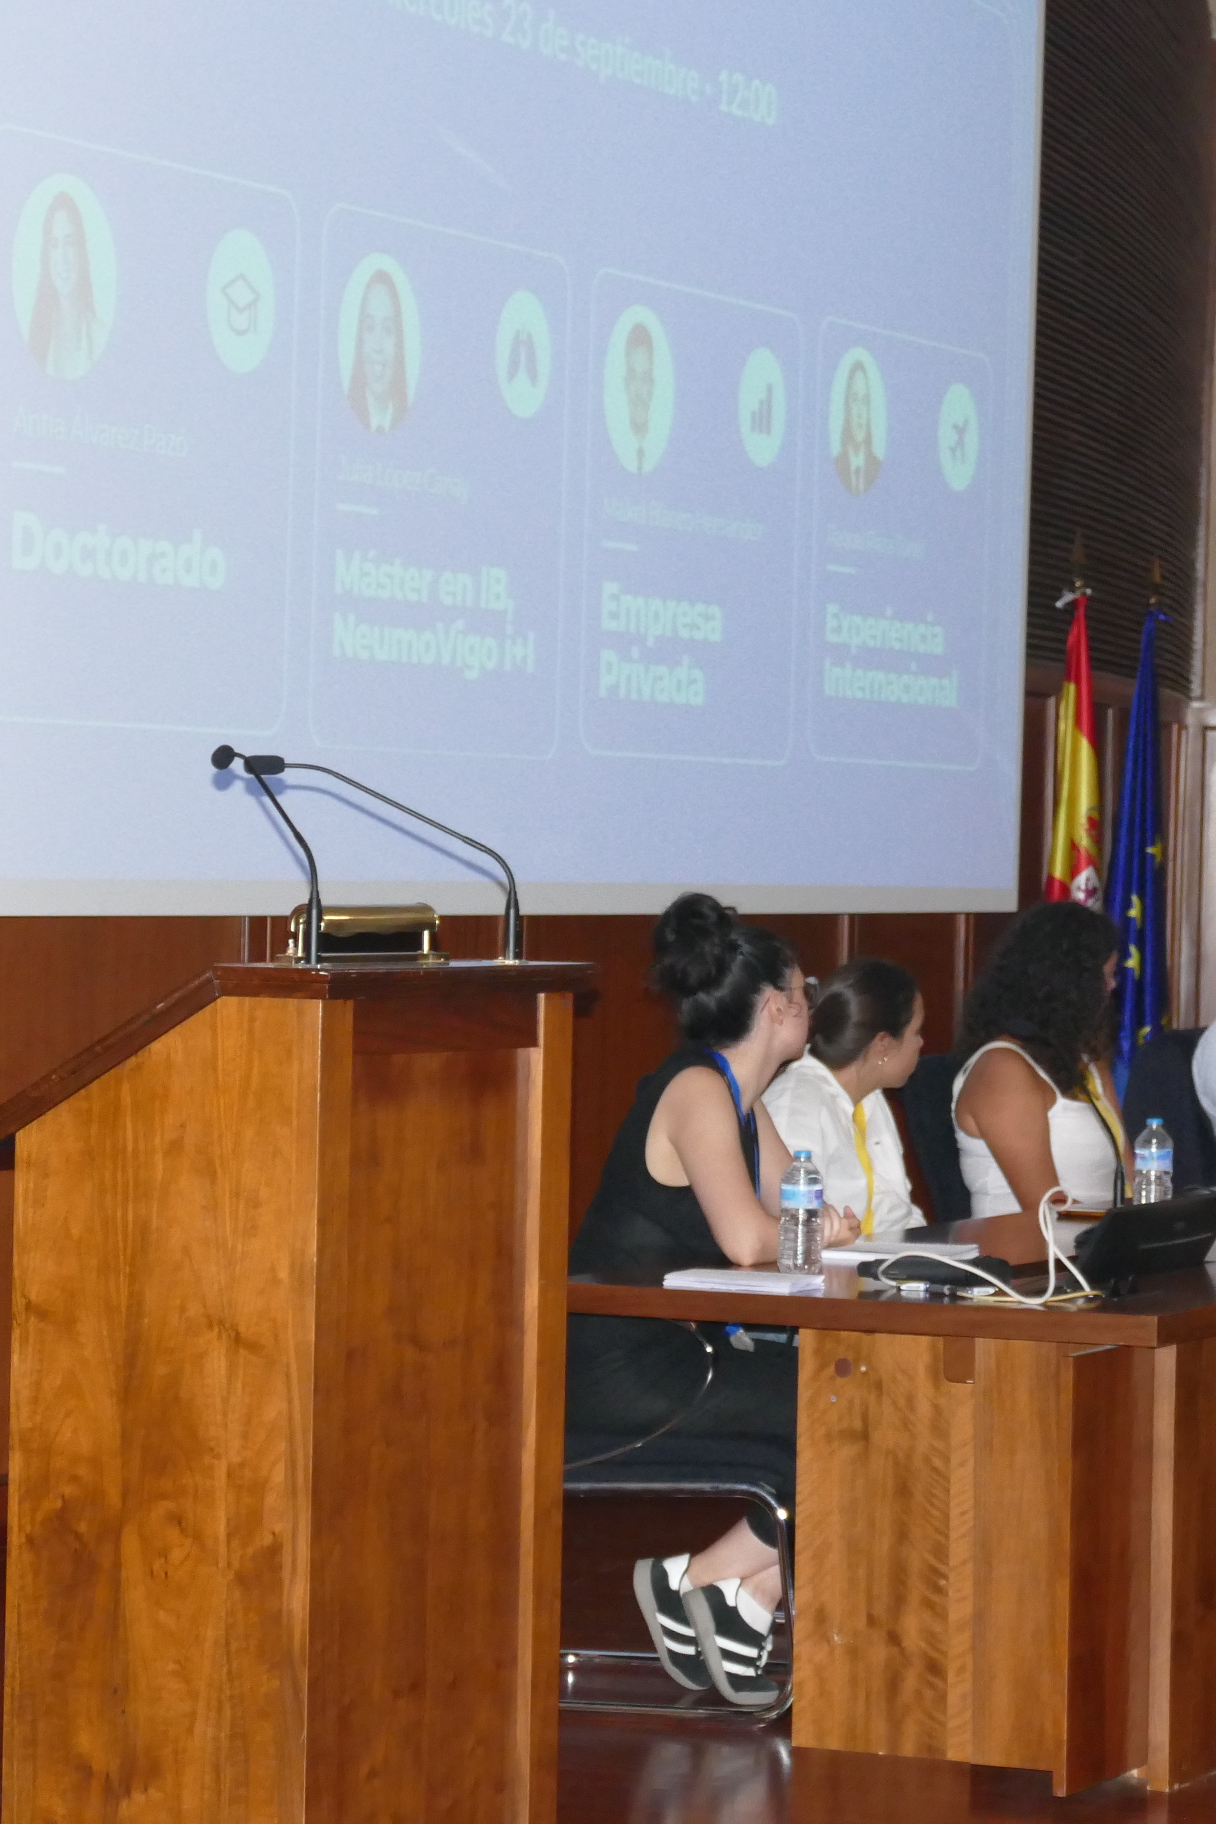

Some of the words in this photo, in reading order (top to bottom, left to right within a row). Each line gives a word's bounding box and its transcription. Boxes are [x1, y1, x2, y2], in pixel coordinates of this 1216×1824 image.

[501, 0, 533, 50] 23
[540, 8, 570, 61] de
[574, 31, 700, 103] septiembre
[718, 69, 777, 126] 12:00
[11, 510, 227, 590] Doctorado
[335, 549, 434, 603] Máster
[439, 571, 473, 607] en
[602, 580, 722, 647] Empresa
[825, 603, 945, 655] Experiencia
[599, 645, 706, 706] Privada
[824, 657, 958, 708] Internacional
